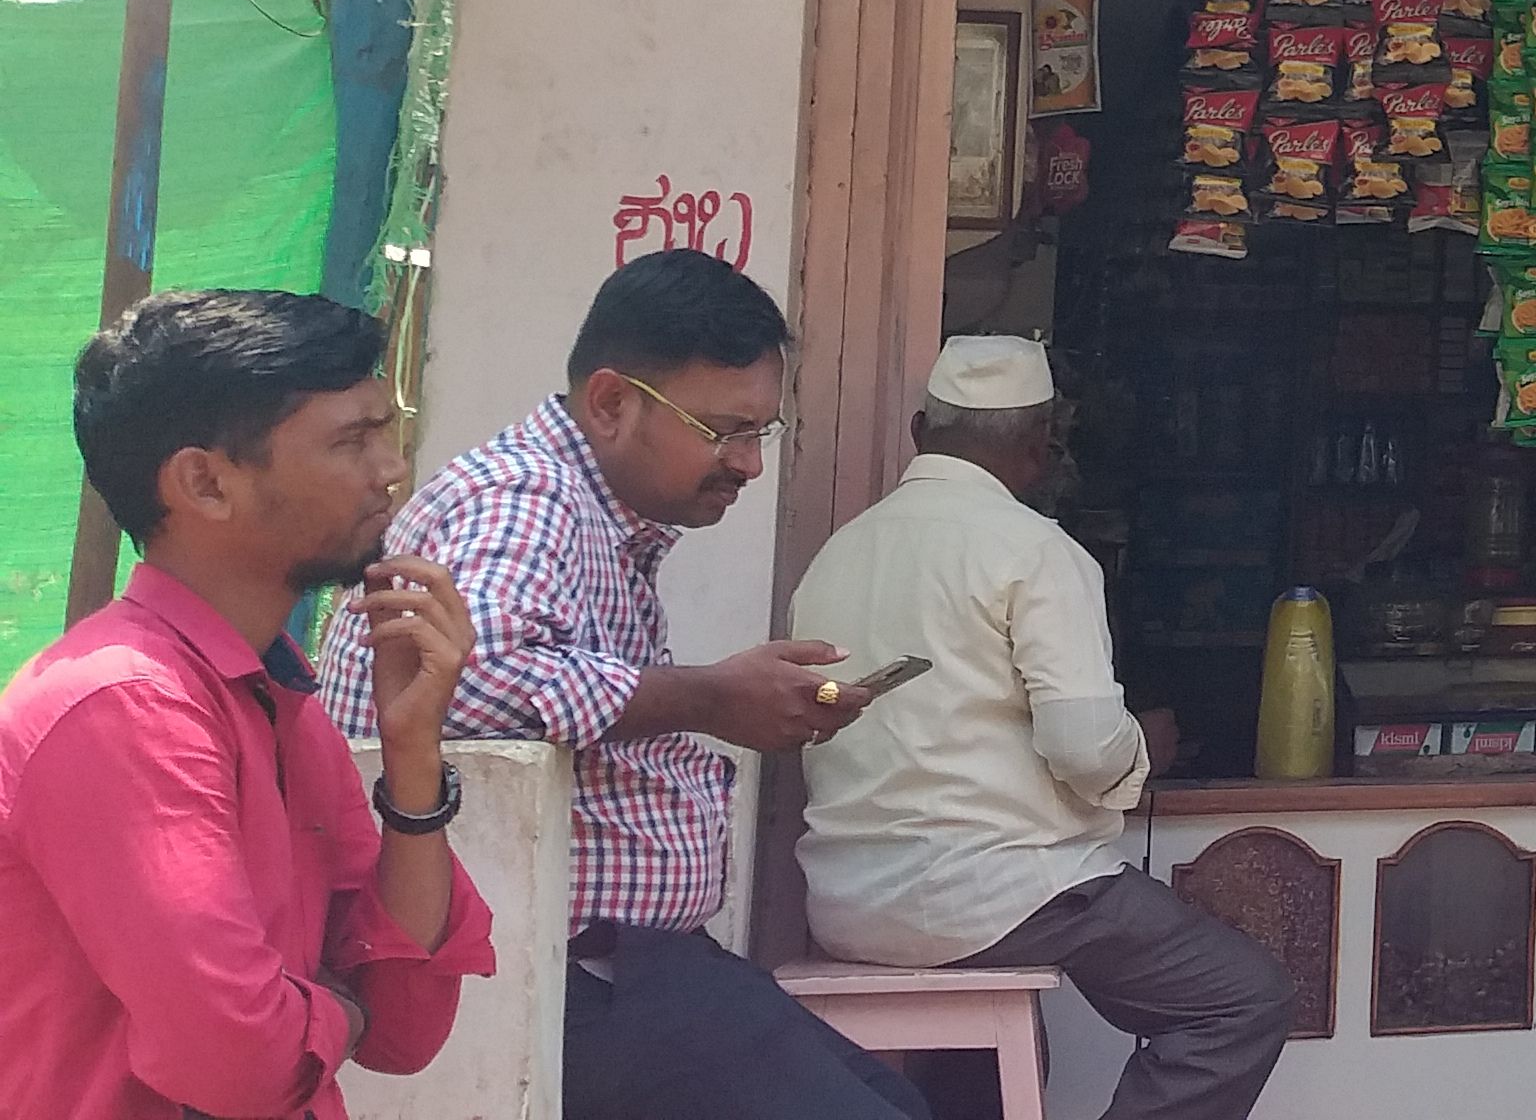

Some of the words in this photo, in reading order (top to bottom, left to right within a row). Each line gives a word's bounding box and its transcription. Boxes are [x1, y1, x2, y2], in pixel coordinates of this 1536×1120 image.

[1273, 33, 1336, 57] Parle's
[1184, 96, 1246, 121] Parle's
[1268, 130, 1331, 154] Parle's
